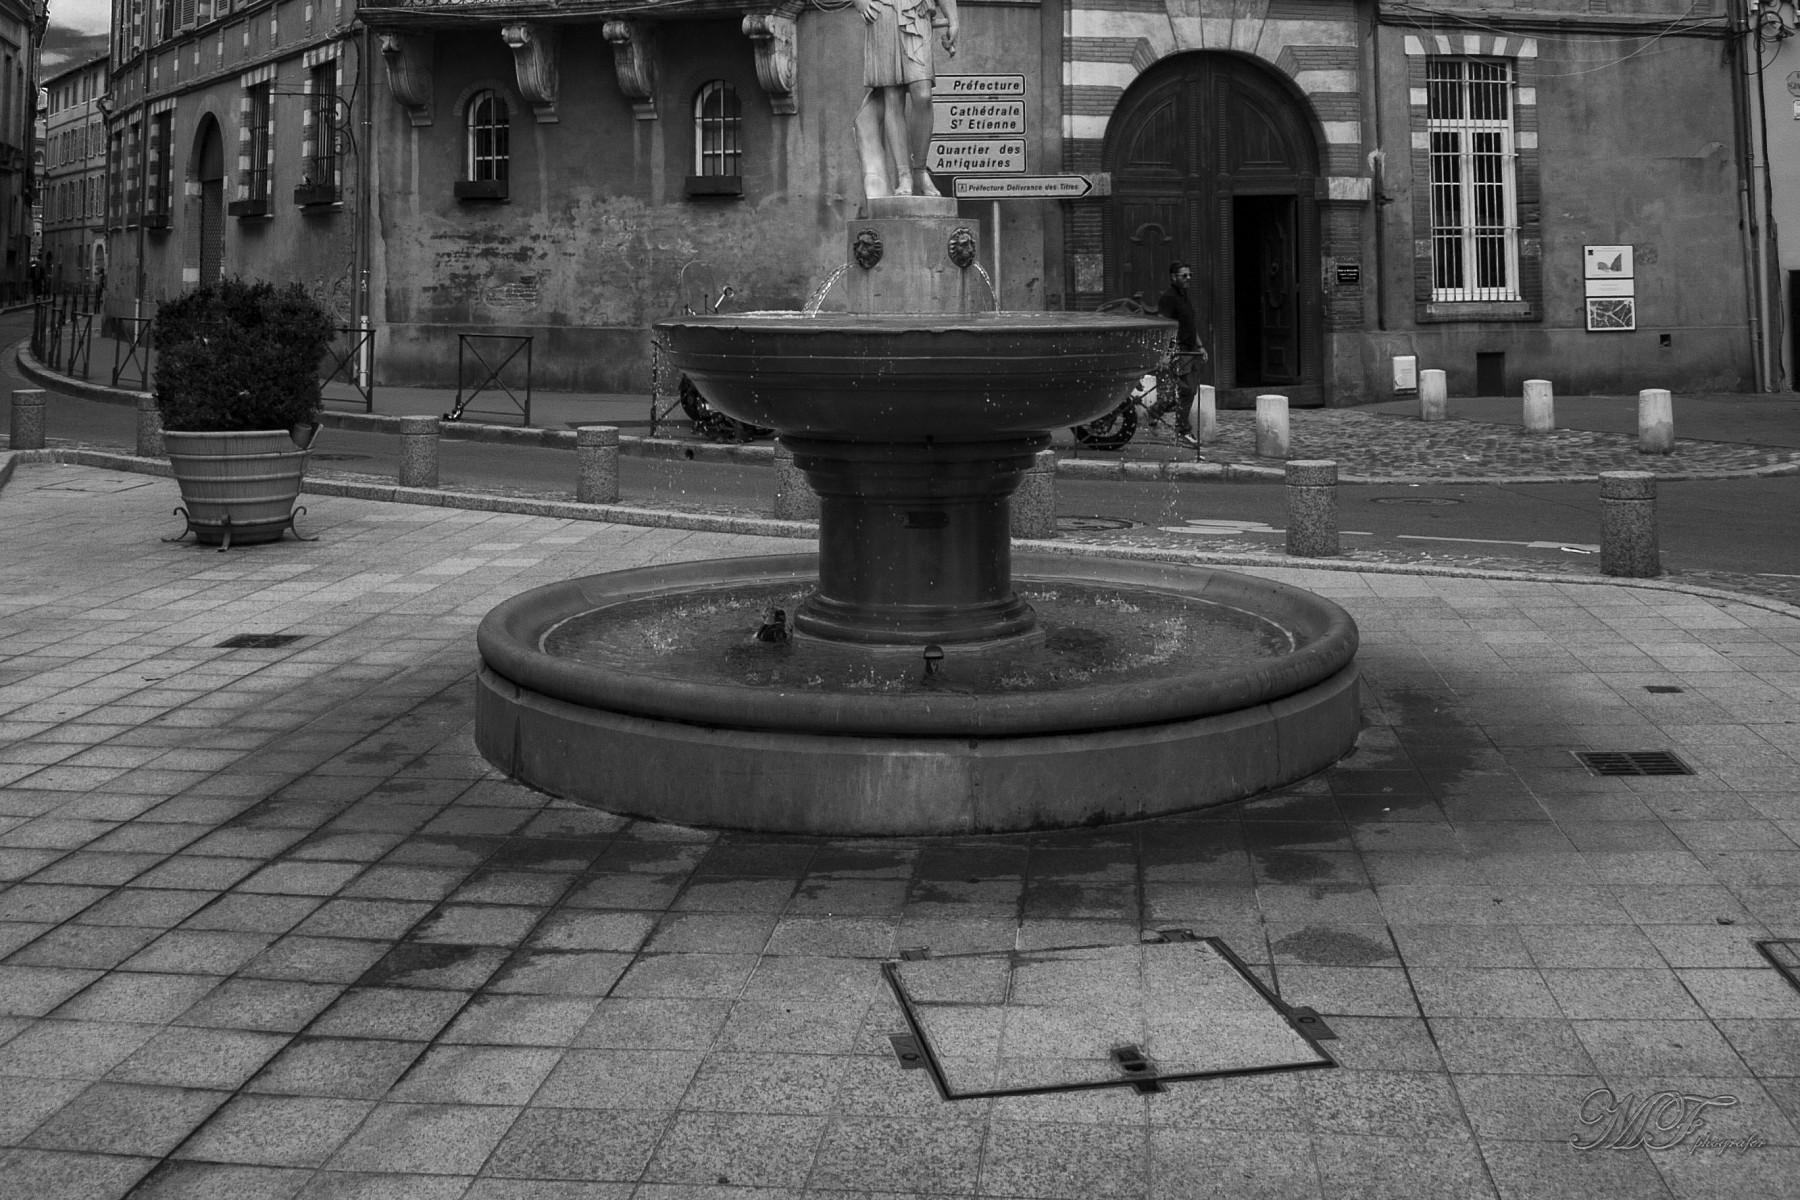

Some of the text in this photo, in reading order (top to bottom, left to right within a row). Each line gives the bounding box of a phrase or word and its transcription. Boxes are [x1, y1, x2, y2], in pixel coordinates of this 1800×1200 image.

[953, 80, 1020, 90] Préfecture
[950, 105, 1020, 116] Cathédrale
[968, 119, 1016, 130] Etienne
[936, 144, 1020, 155] Quartier des
[936, 158, 1011, 170] Antiquaires
[968, 184, 1004, 192] Préfecture
